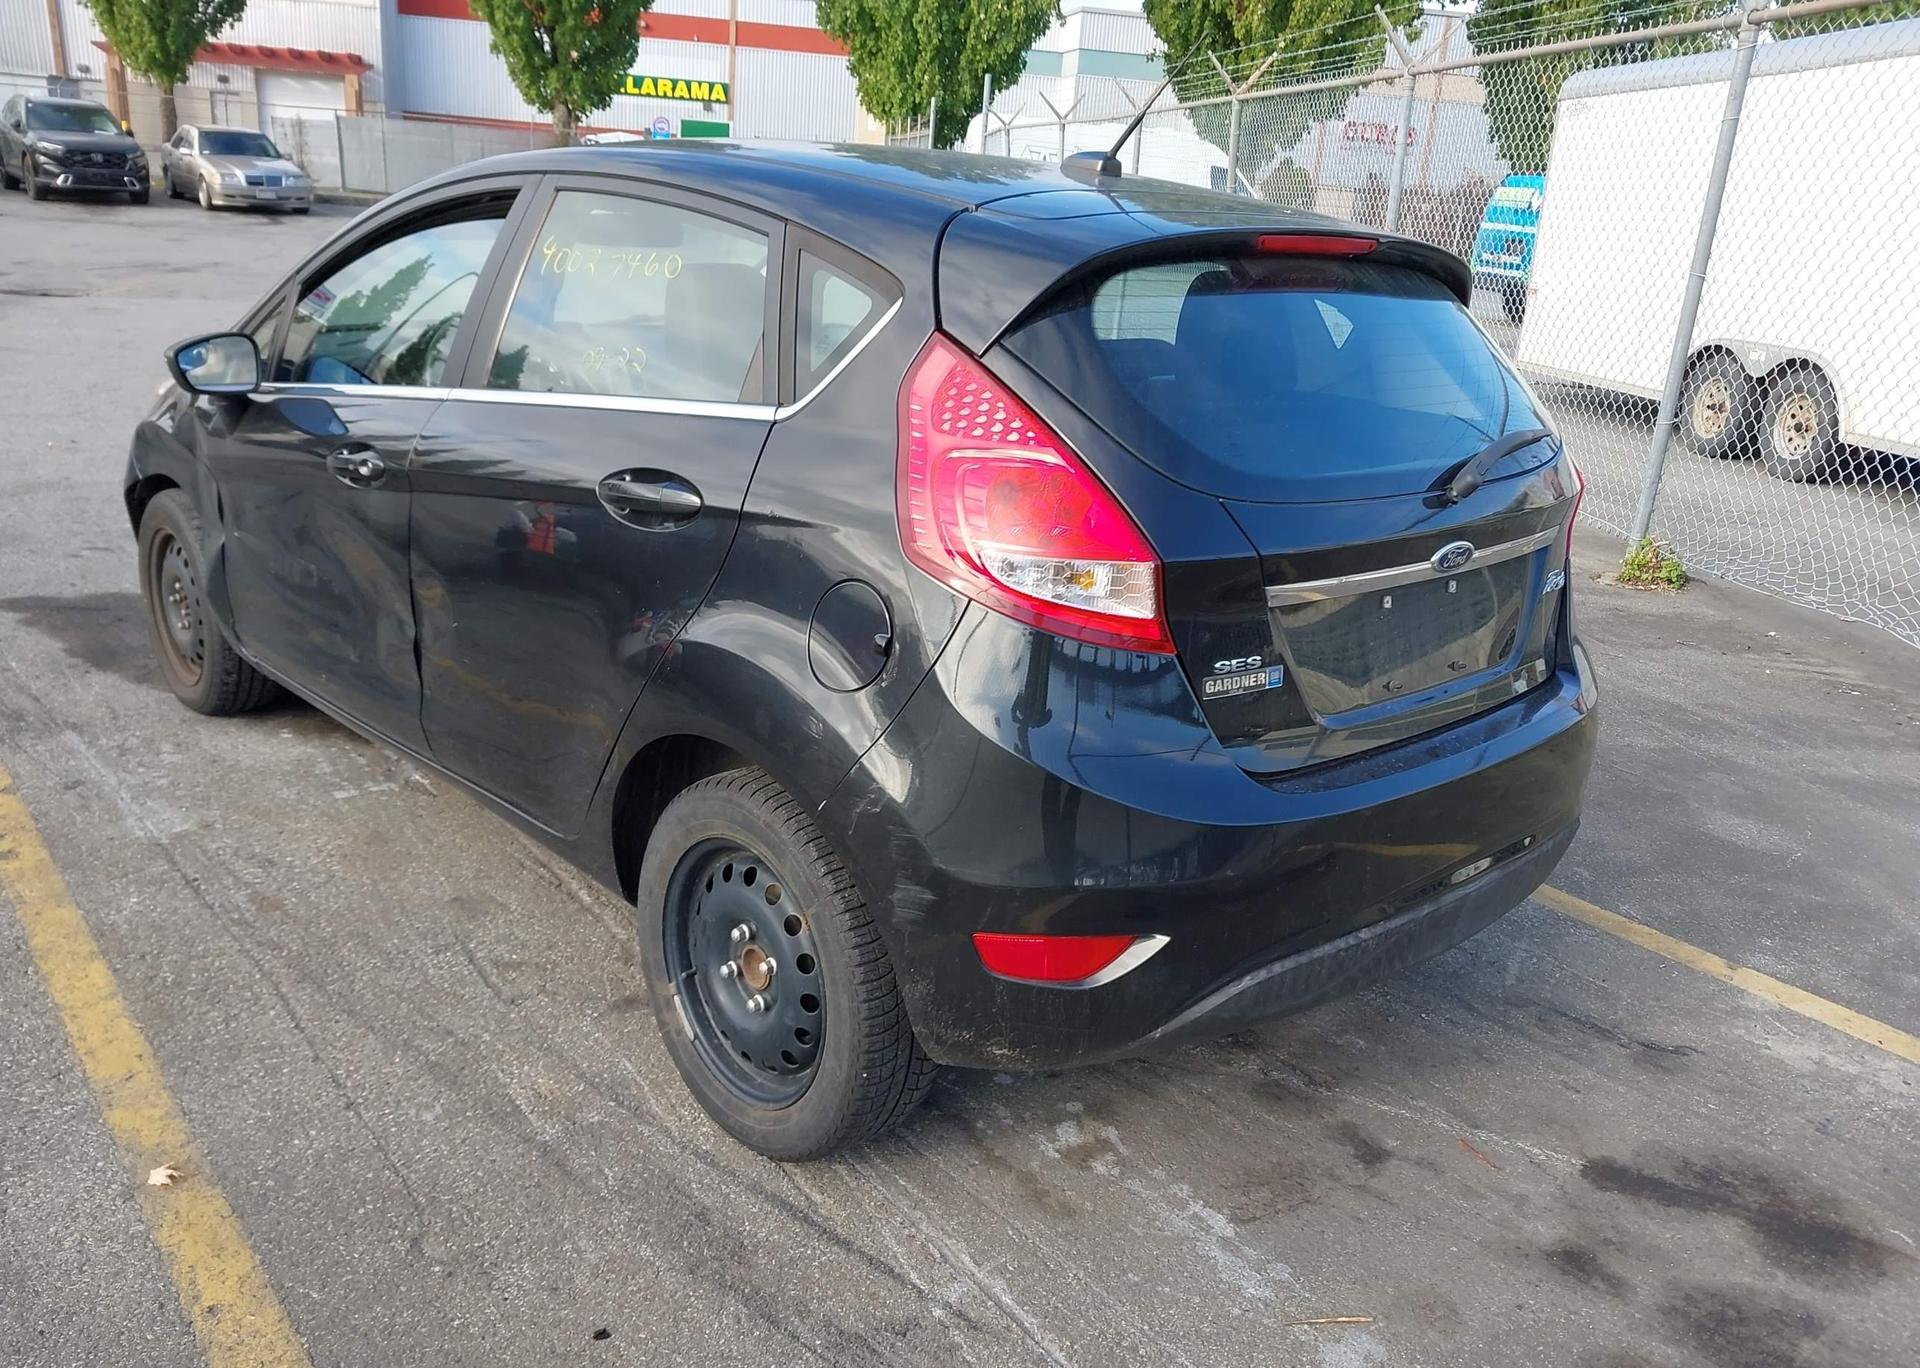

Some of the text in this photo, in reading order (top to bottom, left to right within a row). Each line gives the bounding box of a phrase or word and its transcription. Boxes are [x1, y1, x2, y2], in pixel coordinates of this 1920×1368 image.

[620, 75, 726, 102] LARAMA
[1214, 655, 1262, 674] SES
[1205, 672, 1266, 693] GARDNER
